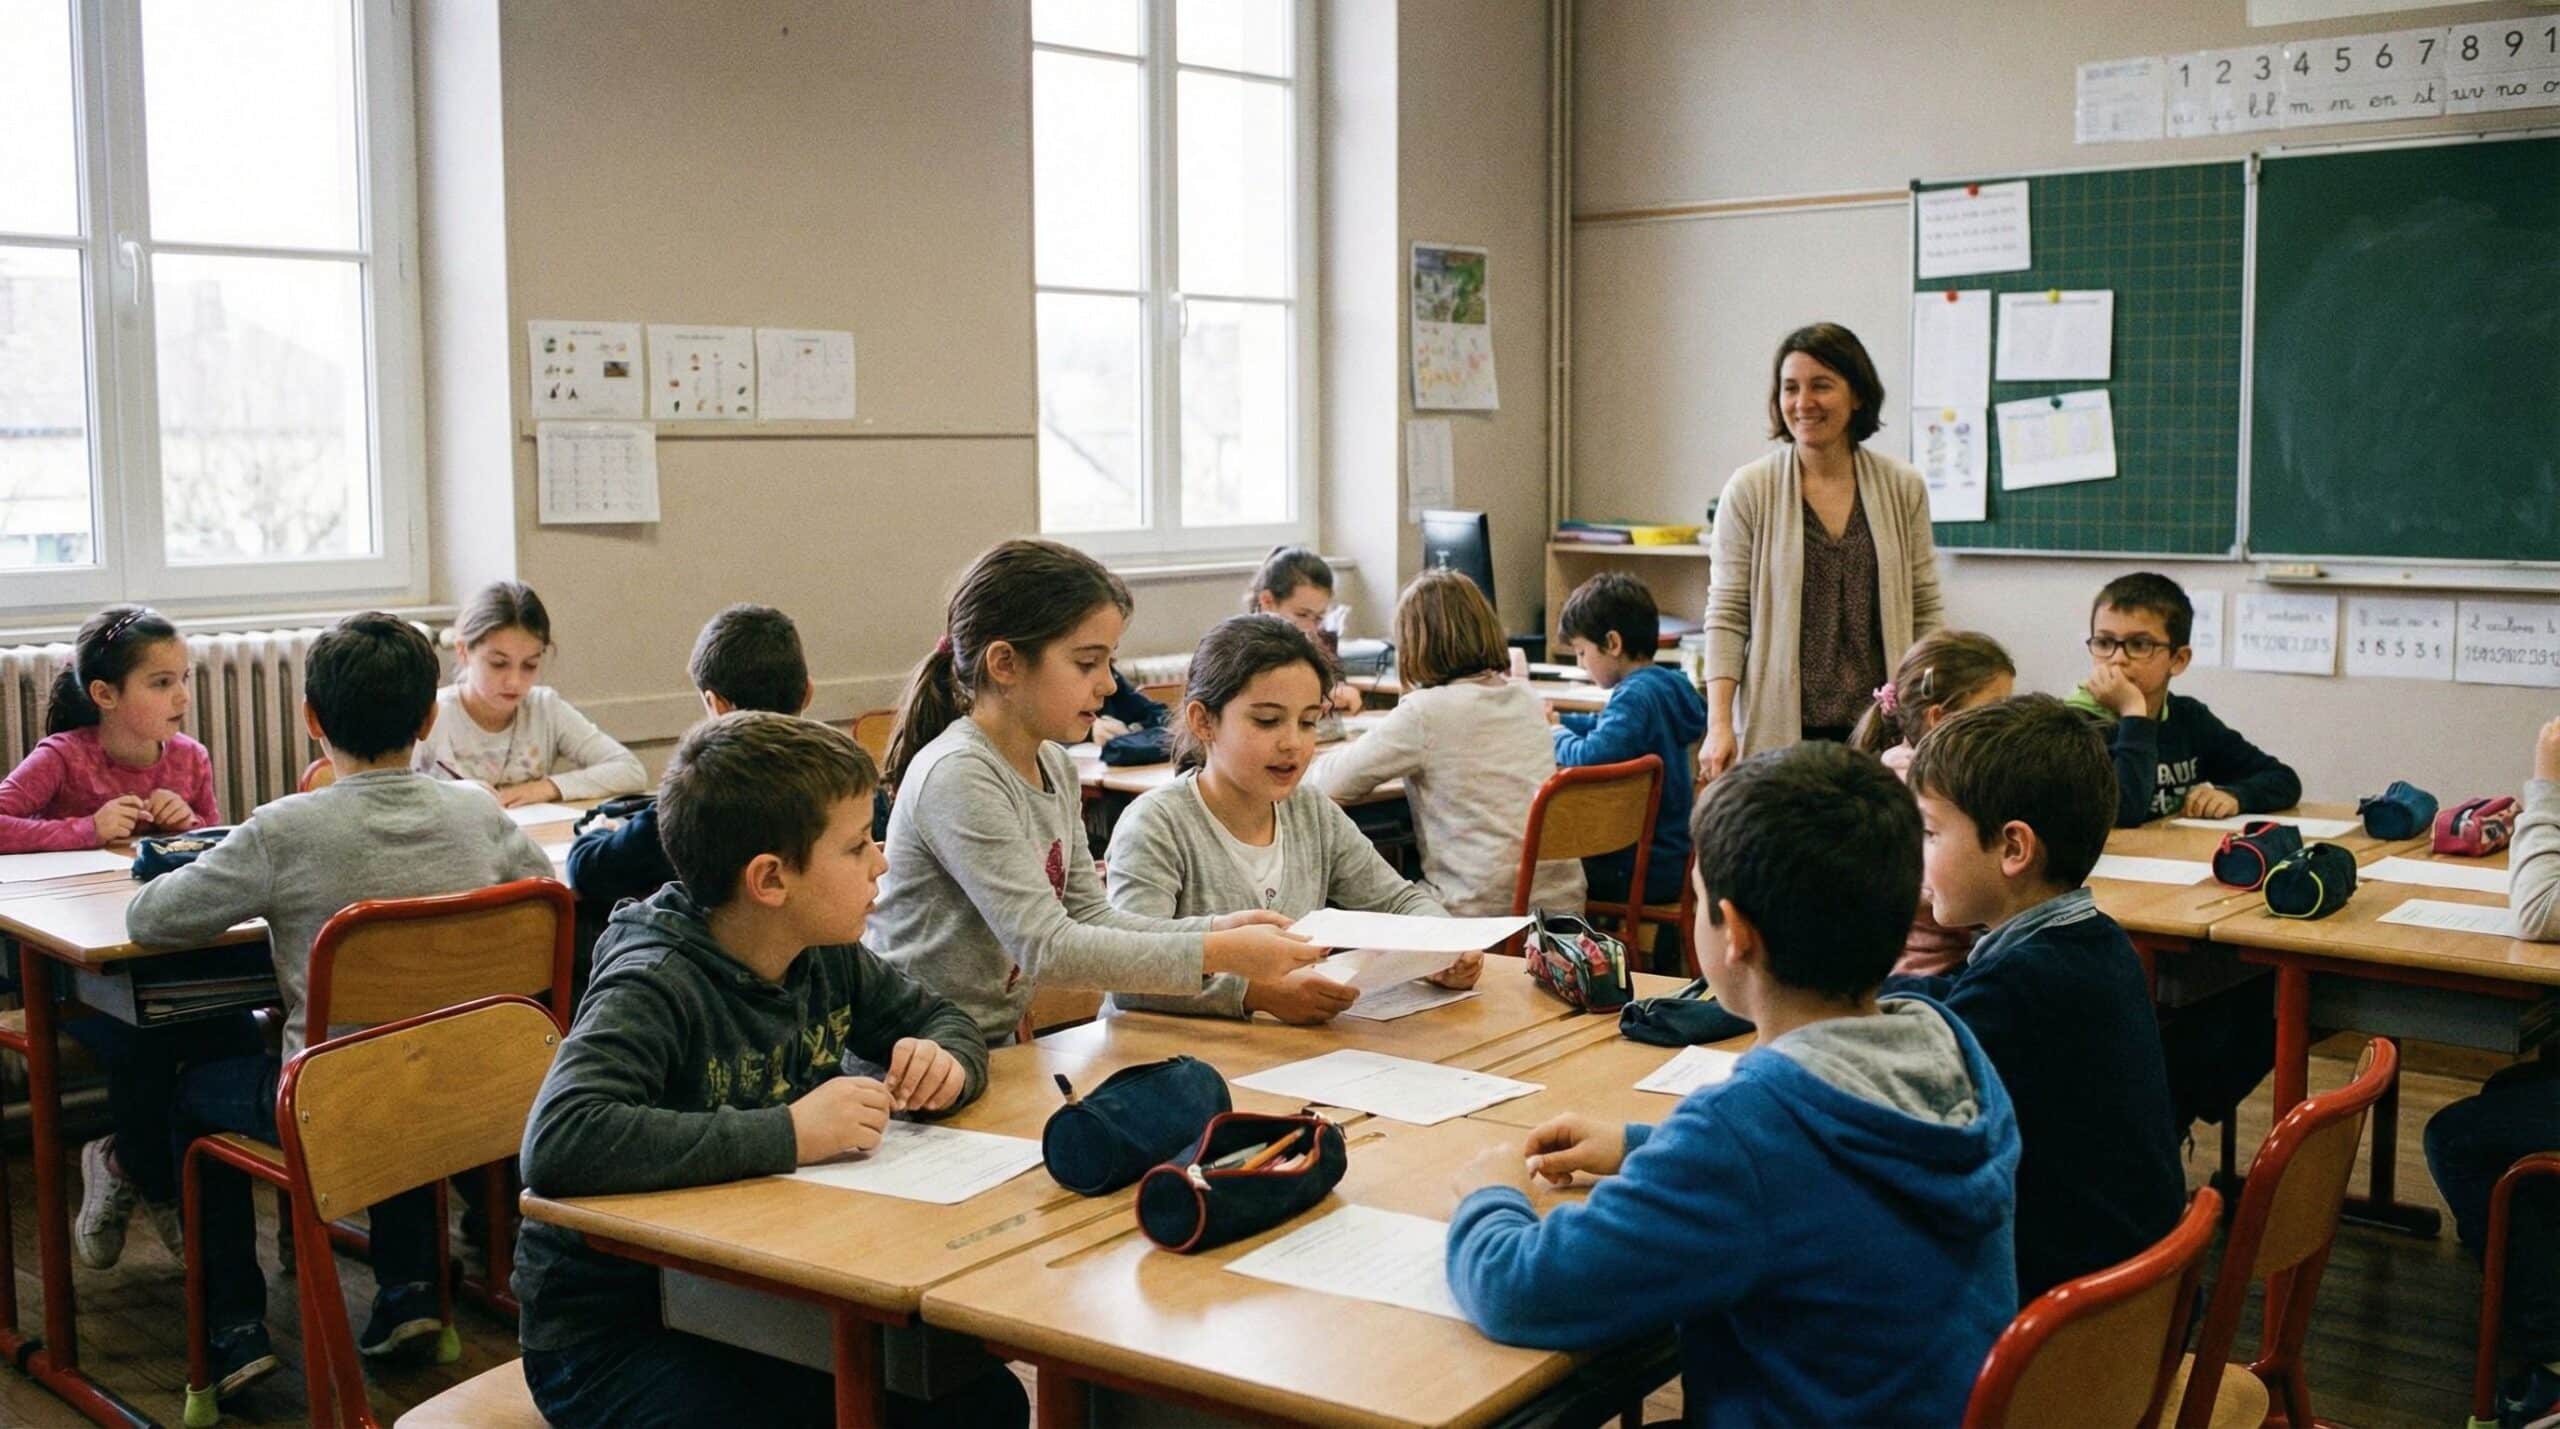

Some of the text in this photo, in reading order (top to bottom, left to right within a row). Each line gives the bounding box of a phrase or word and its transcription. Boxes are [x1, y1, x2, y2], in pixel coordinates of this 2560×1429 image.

[2179, 63, 2189, 88] 1
[2216, 59, 2232, 84] 2
[2254, 55, 2271, 80] 3
[2293, 51, 2310, 76] 4
[2334, 47, 2351, 73] 5
[2375, 43, 2393, 69] 6
[2418, 38, 2436, 65] 7
[2461, 35, 2479, 61] 8
[2505, 30, 2524, 57] 9
